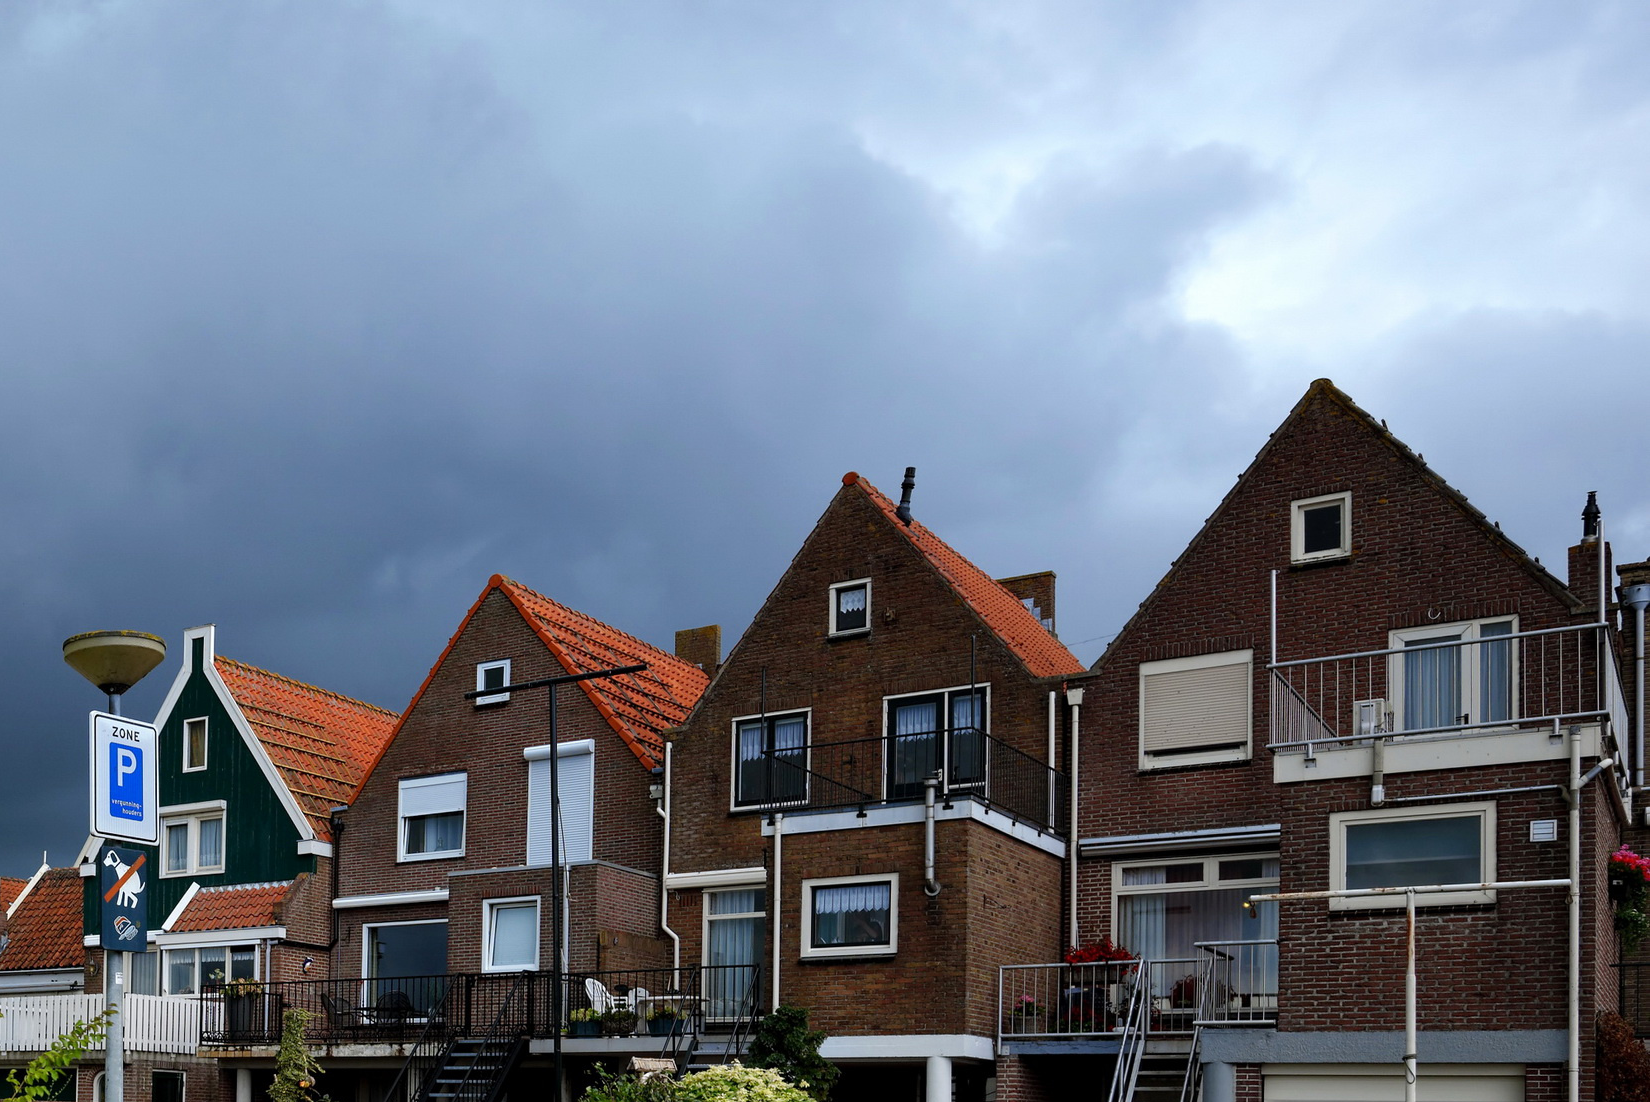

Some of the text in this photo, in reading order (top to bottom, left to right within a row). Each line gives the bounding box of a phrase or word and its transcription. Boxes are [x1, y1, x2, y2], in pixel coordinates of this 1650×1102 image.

[112, 726, 140, 742] ZONE
[117, 747, 137, 787] P
[122, 808, 142, 818] houders
